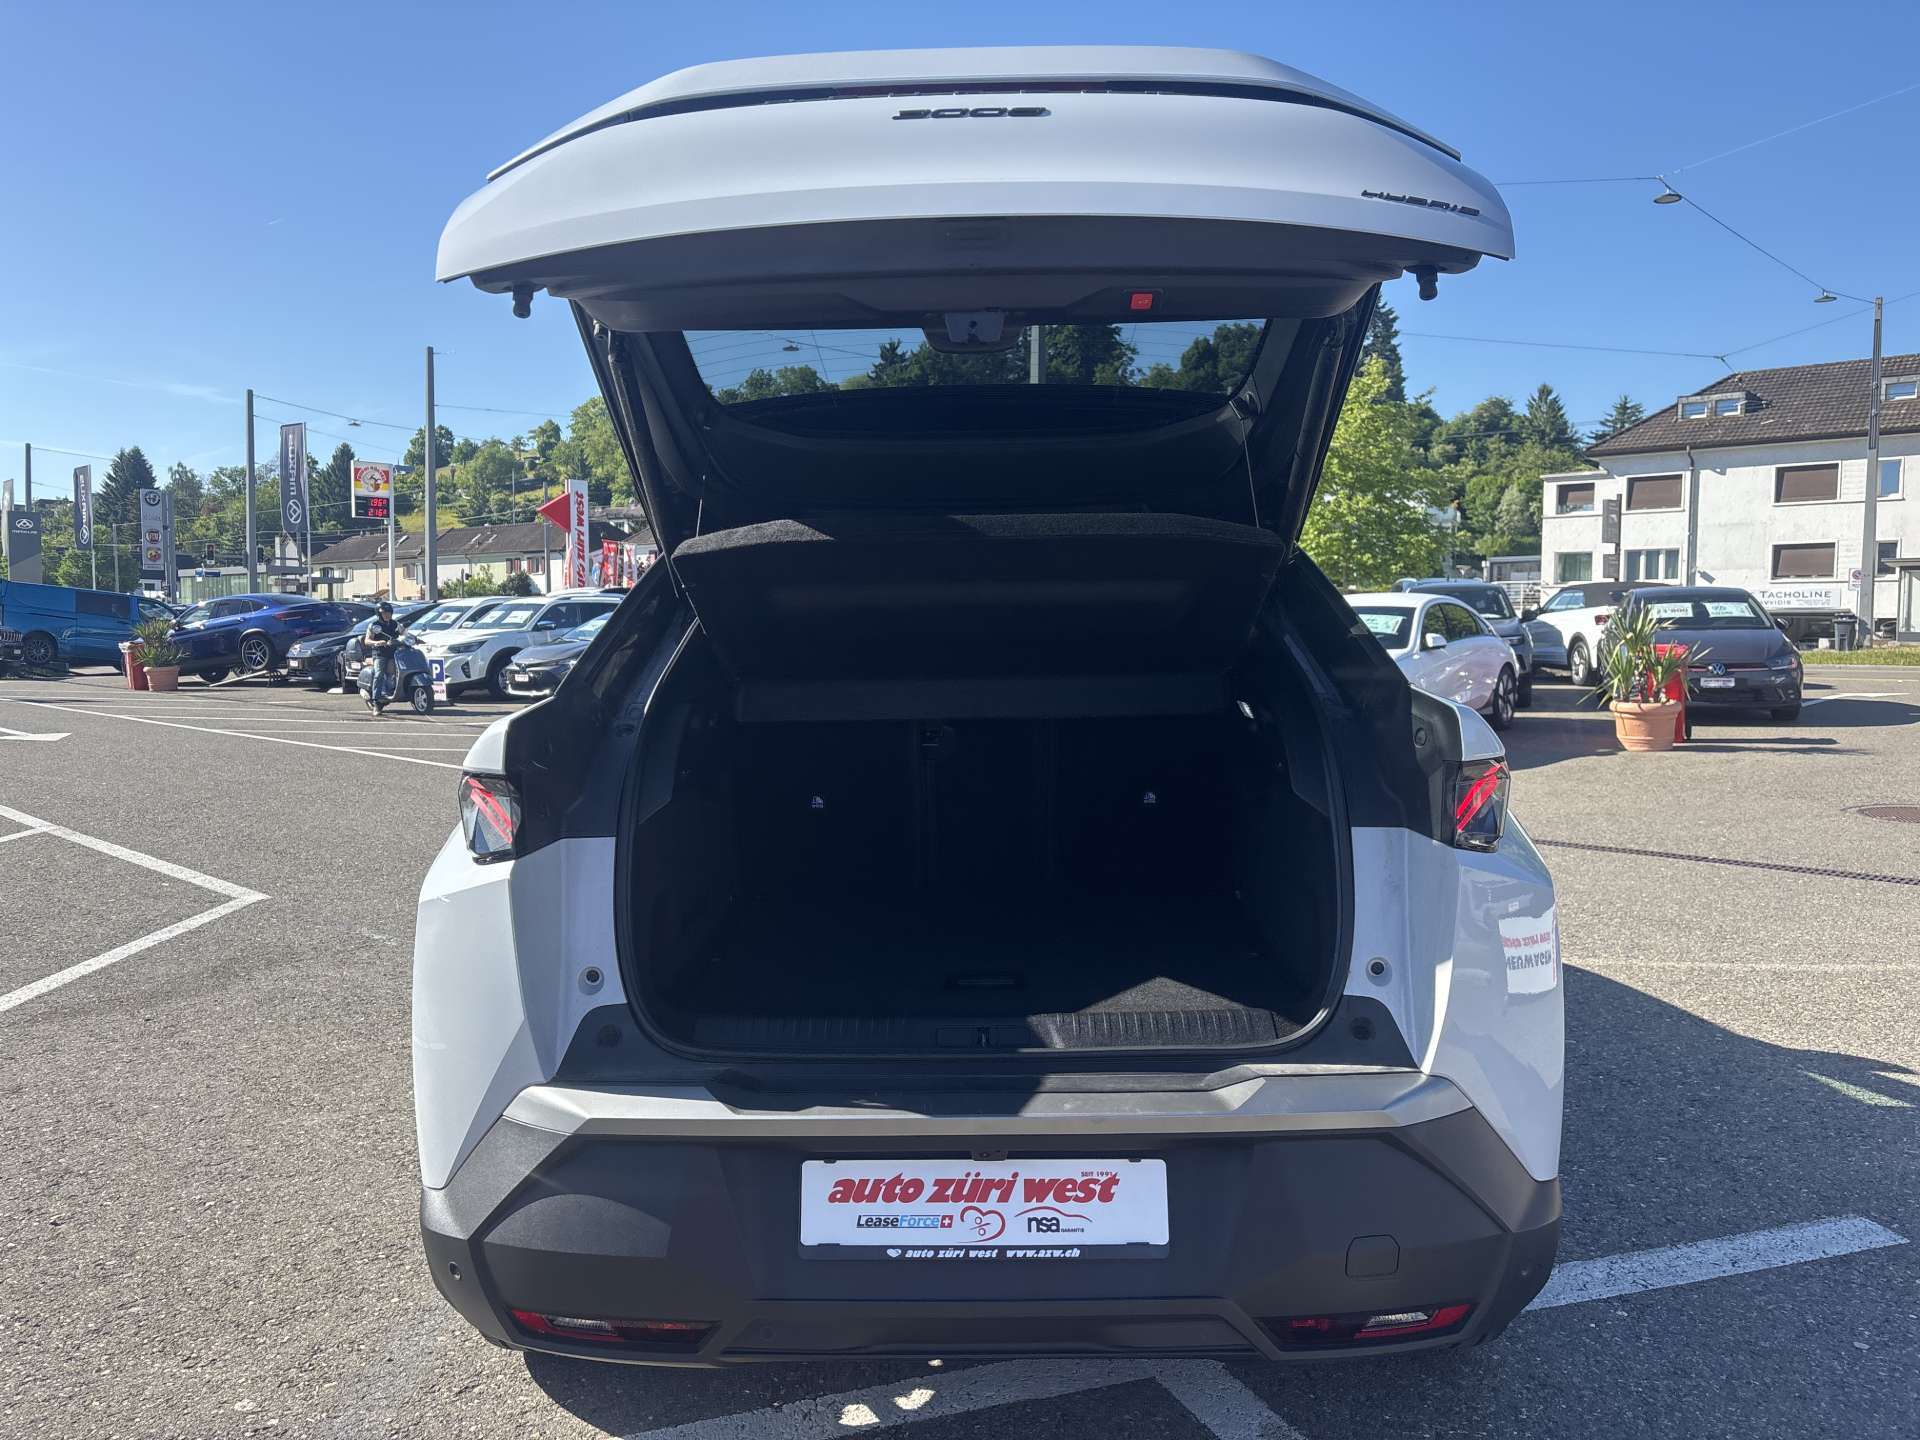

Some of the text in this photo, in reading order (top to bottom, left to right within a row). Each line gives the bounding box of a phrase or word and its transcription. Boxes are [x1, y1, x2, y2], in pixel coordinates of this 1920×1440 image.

[1760, 591, 1832, 599] TACHOLINE
[432, 663, 441, 679] P
[828, 1171, 1120, 1203] auto züri west
[856, 1214, 940, 1228] LeaseForce
[1027, 1217, 1060, 1233] nsa
[905, 1250, 935, 1258] auto
[968, 1249, 998, 1258] west
